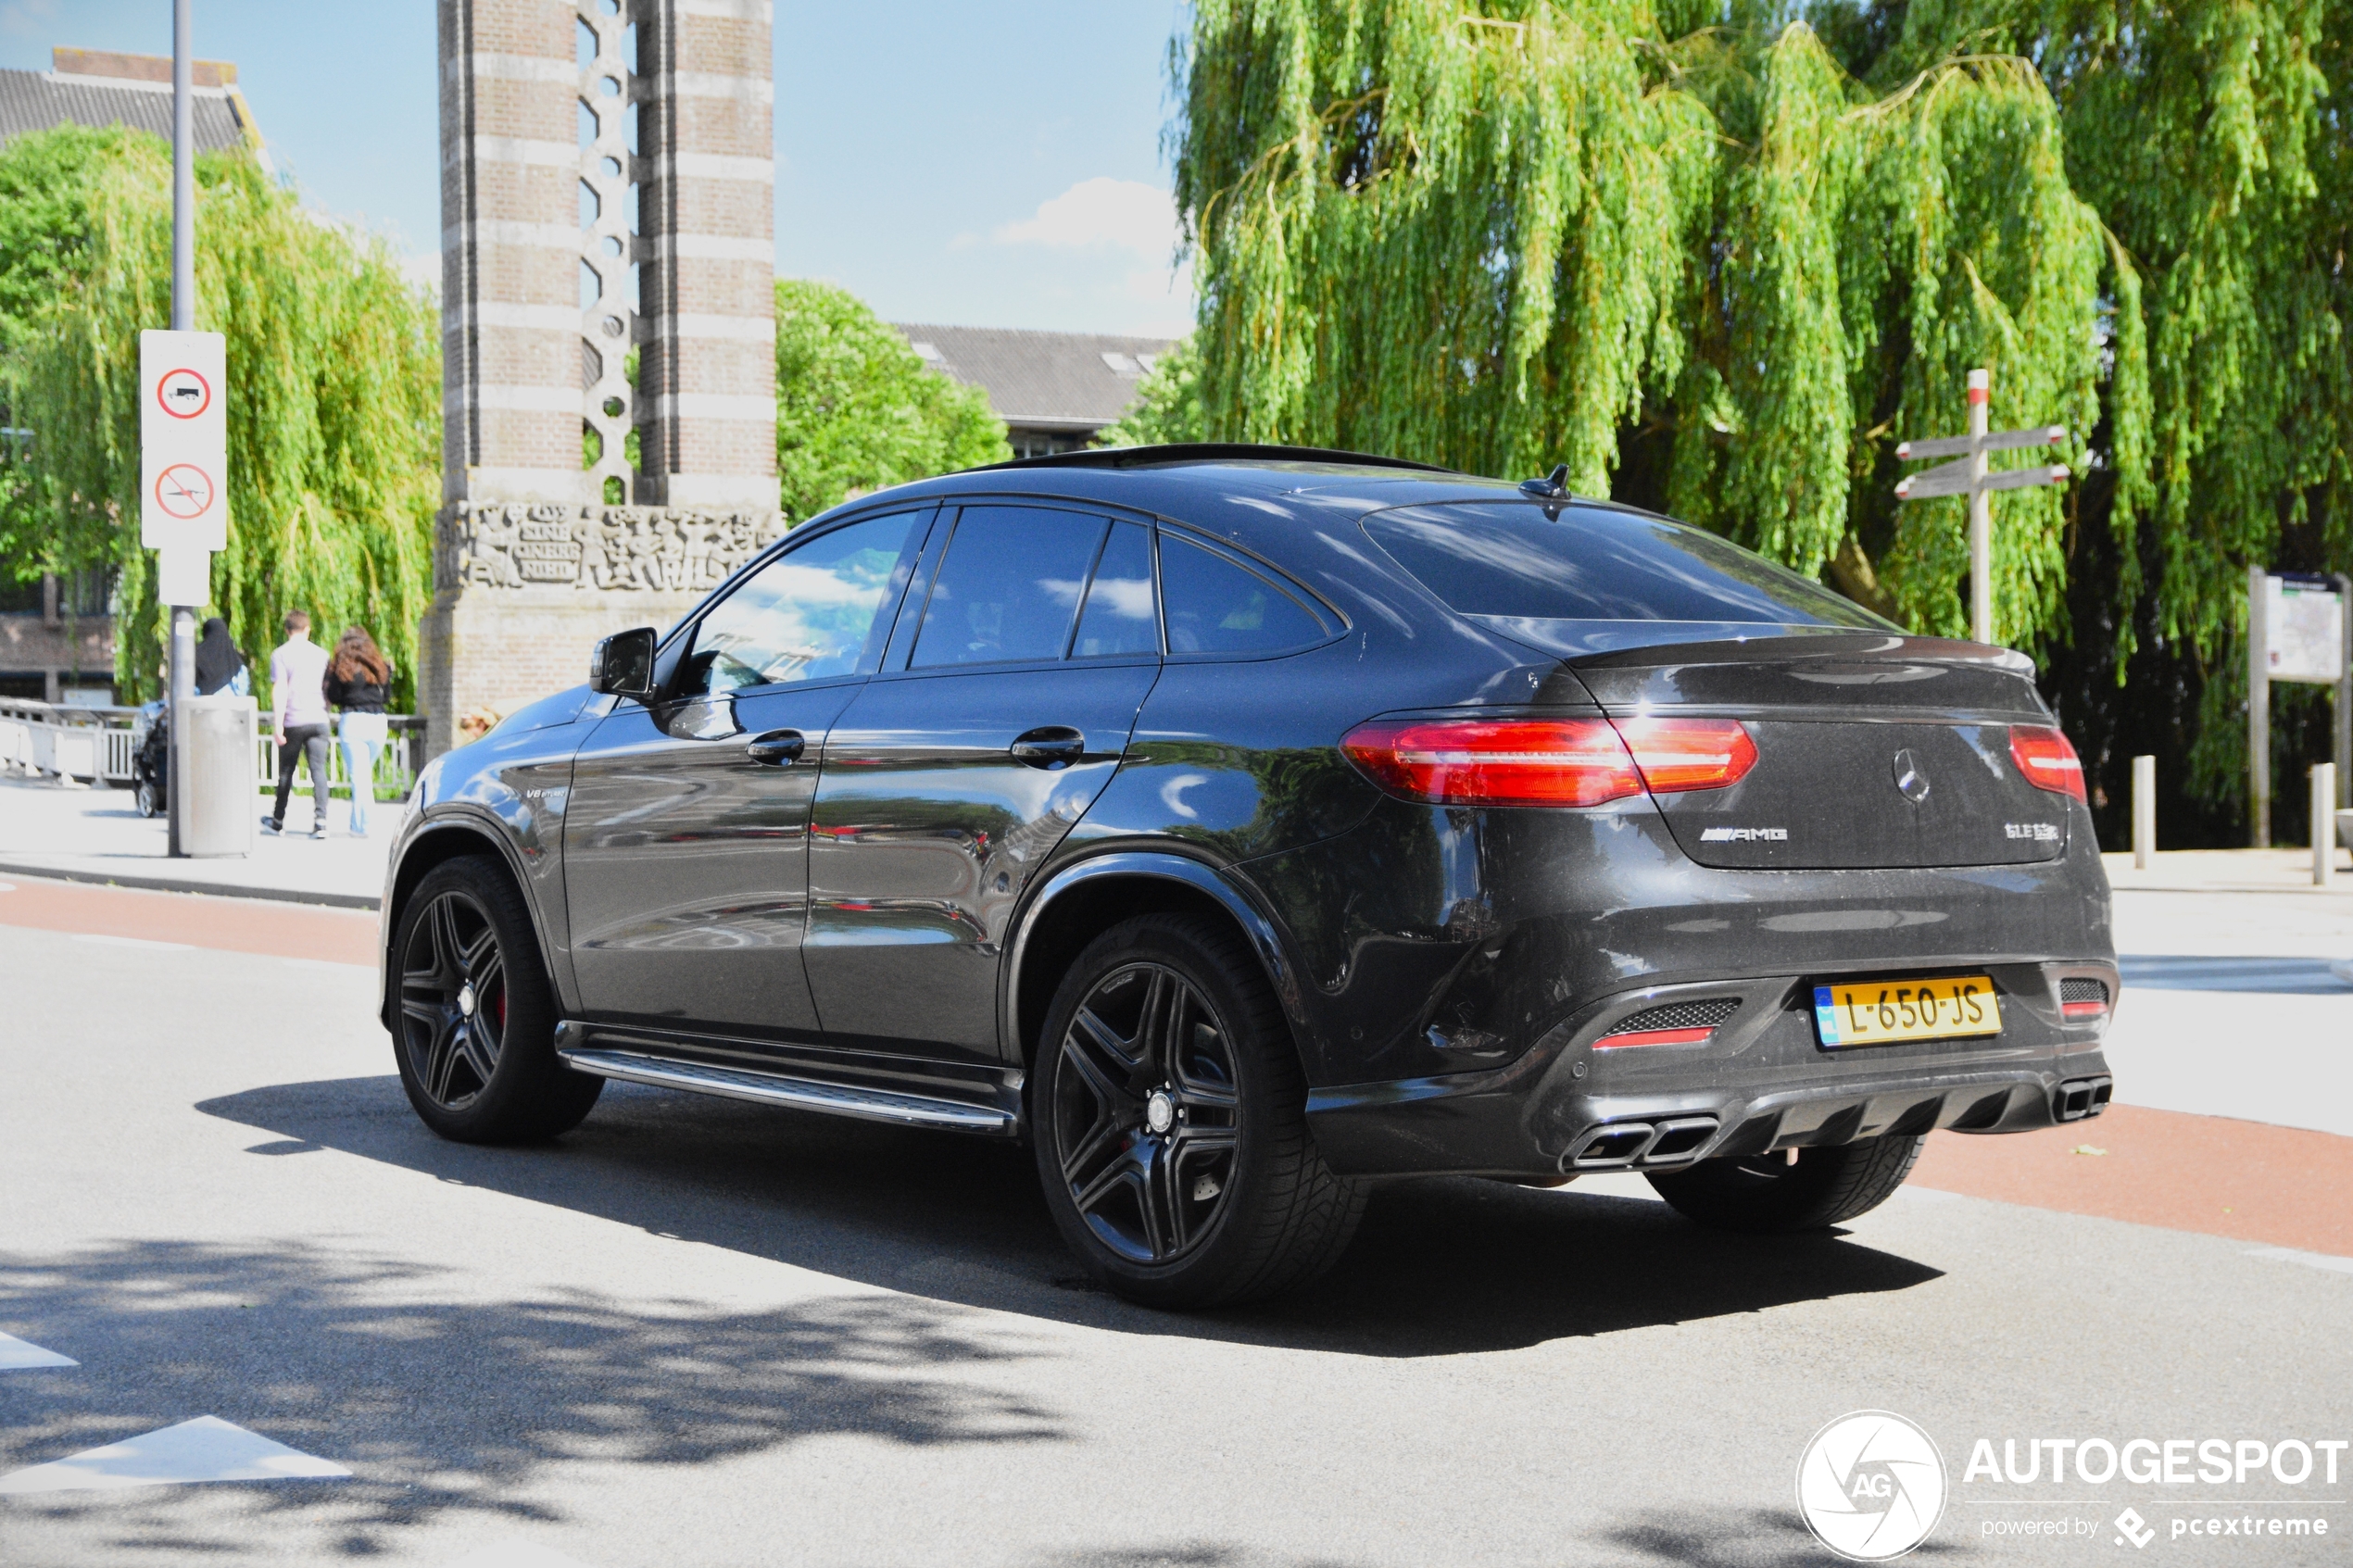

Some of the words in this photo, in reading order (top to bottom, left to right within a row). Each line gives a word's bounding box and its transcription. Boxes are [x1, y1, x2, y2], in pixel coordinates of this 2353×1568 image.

[526, 789, 541, 798] V8
[1730, 828, 1788, 841] AMG
[1845, 985, 1983, 1033] L-650-JS
